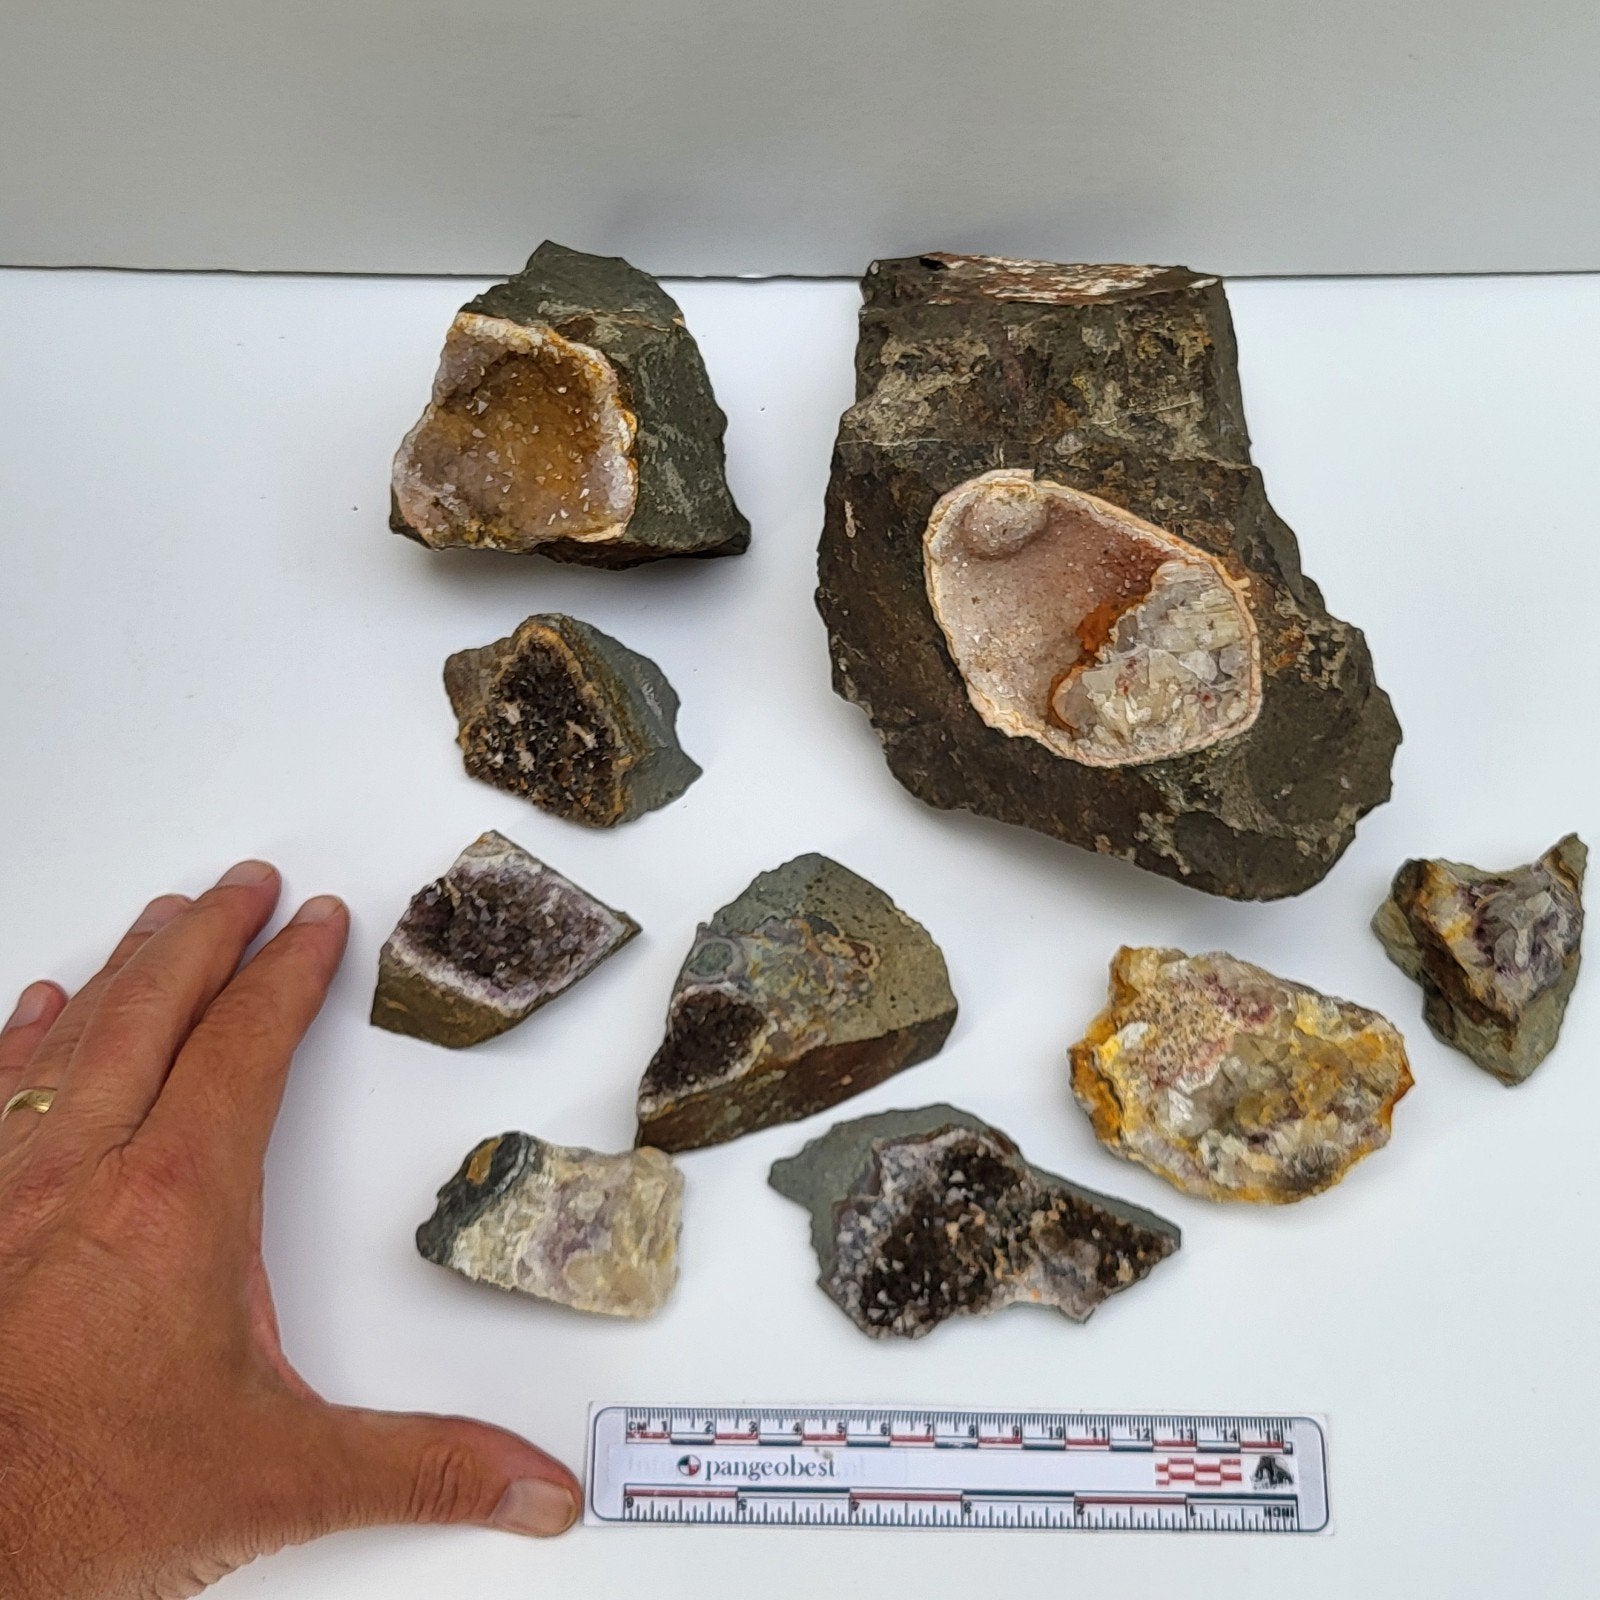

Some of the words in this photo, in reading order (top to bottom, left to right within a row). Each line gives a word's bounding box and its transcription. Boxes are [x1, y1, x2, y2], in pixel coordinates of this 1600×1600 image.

[661, 1421, 668, 1432] 1
[704, 1421, 713, 1433] 2
[749, 1421, 758, 1433] 3
[793, 1422, 801, 1434] 4
[837, 1422, 845, 1434] 5
[880, 1422, 889, 1435] 6
[924, 1423, 932, 1435] 7
[968, 1424, 975, 1437] 8
[1012, 1425, 1020, 1437] 9
[1049, 1425, 1064, 1438] 10
[1091, 1426, 1106, 1439] 11
[1134, 1427, 1150, 1440] 12
[1177, 1428, 1195, 1441] 13
[1221, 1429, 1238, 1442] 14
[1265, 1430, 1281, 1442] 15
[705, 1453, 835, 1481] pangeobest
[963, 1501, 973, 1513] 3
[1076, 1502, 1085, 1515] 2
[1190, 1503, 1197, 1516] 1
[1263, 1505, 1295, 1518] INCH
